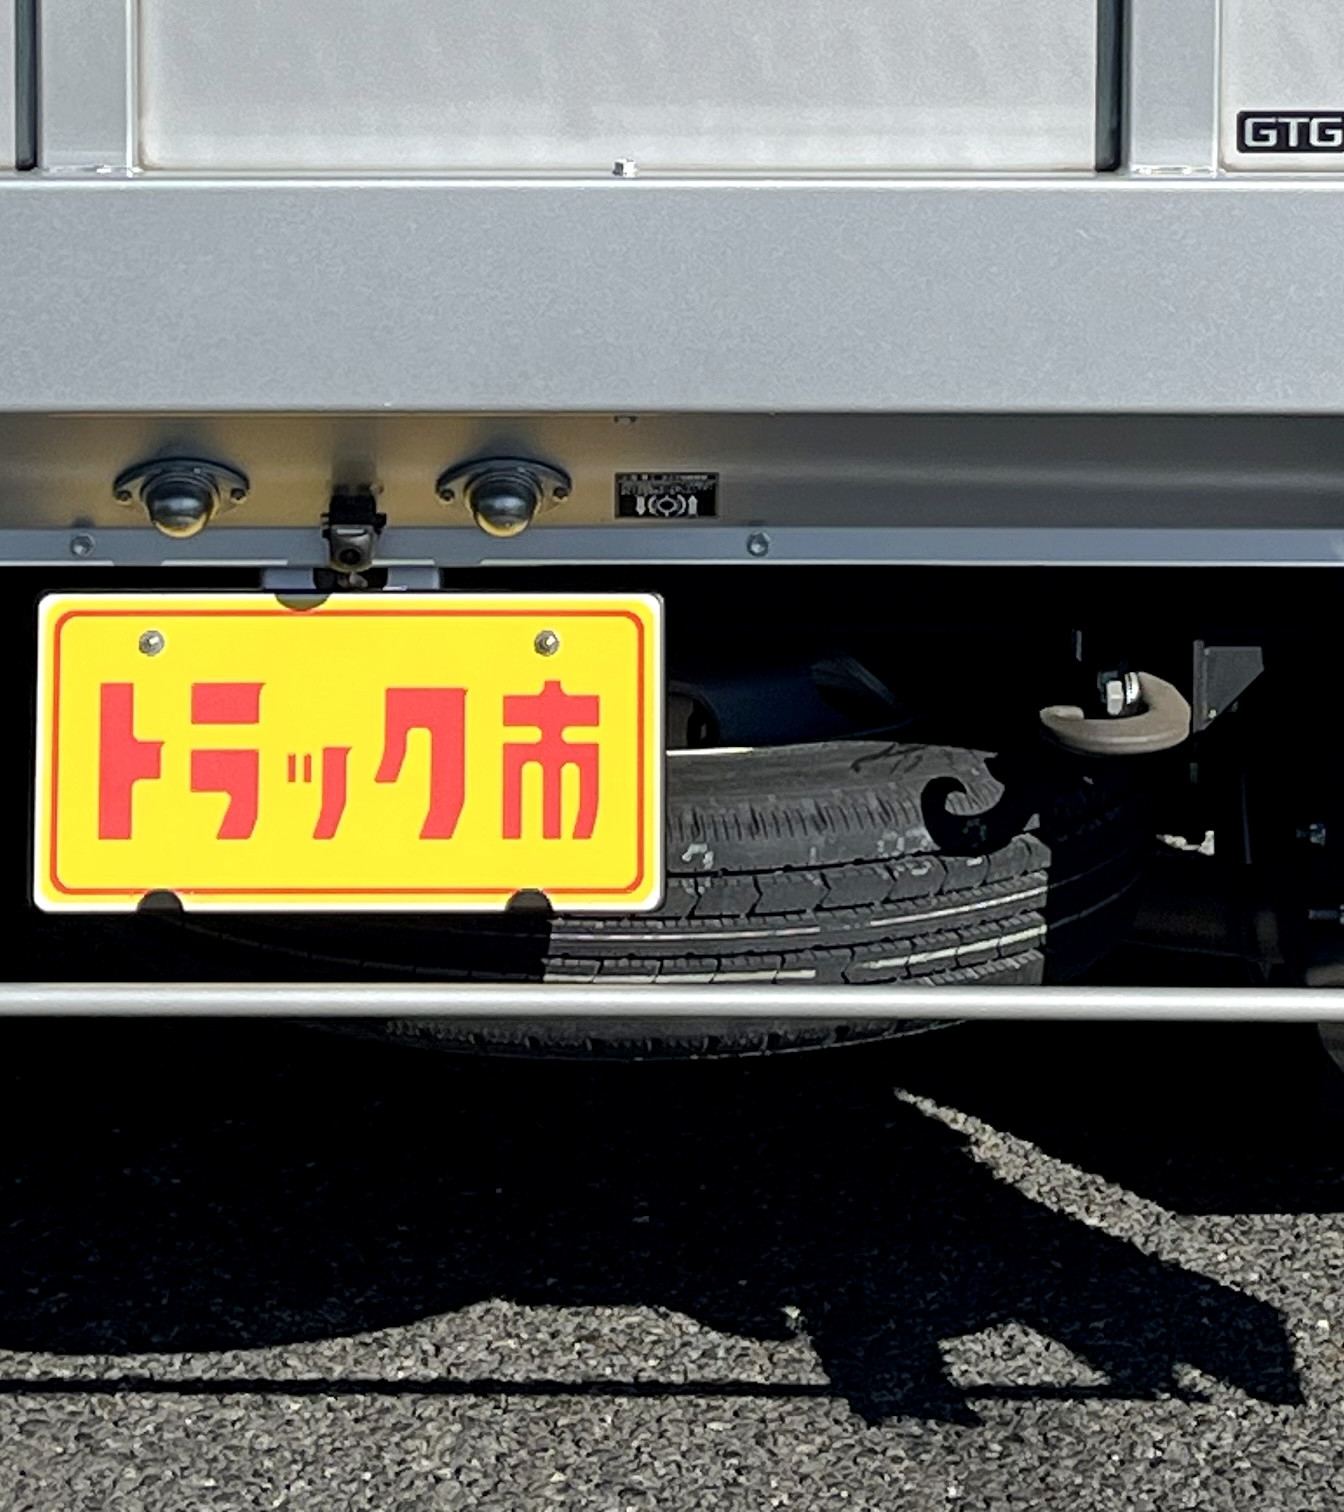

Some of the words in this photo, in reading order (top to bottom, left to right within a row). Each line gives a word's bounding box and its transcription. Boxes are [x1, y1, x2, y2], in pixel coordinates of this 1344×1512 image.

[1244, 116, 1343, 148] GTG
[97, 680, 600, 840] トラック市
